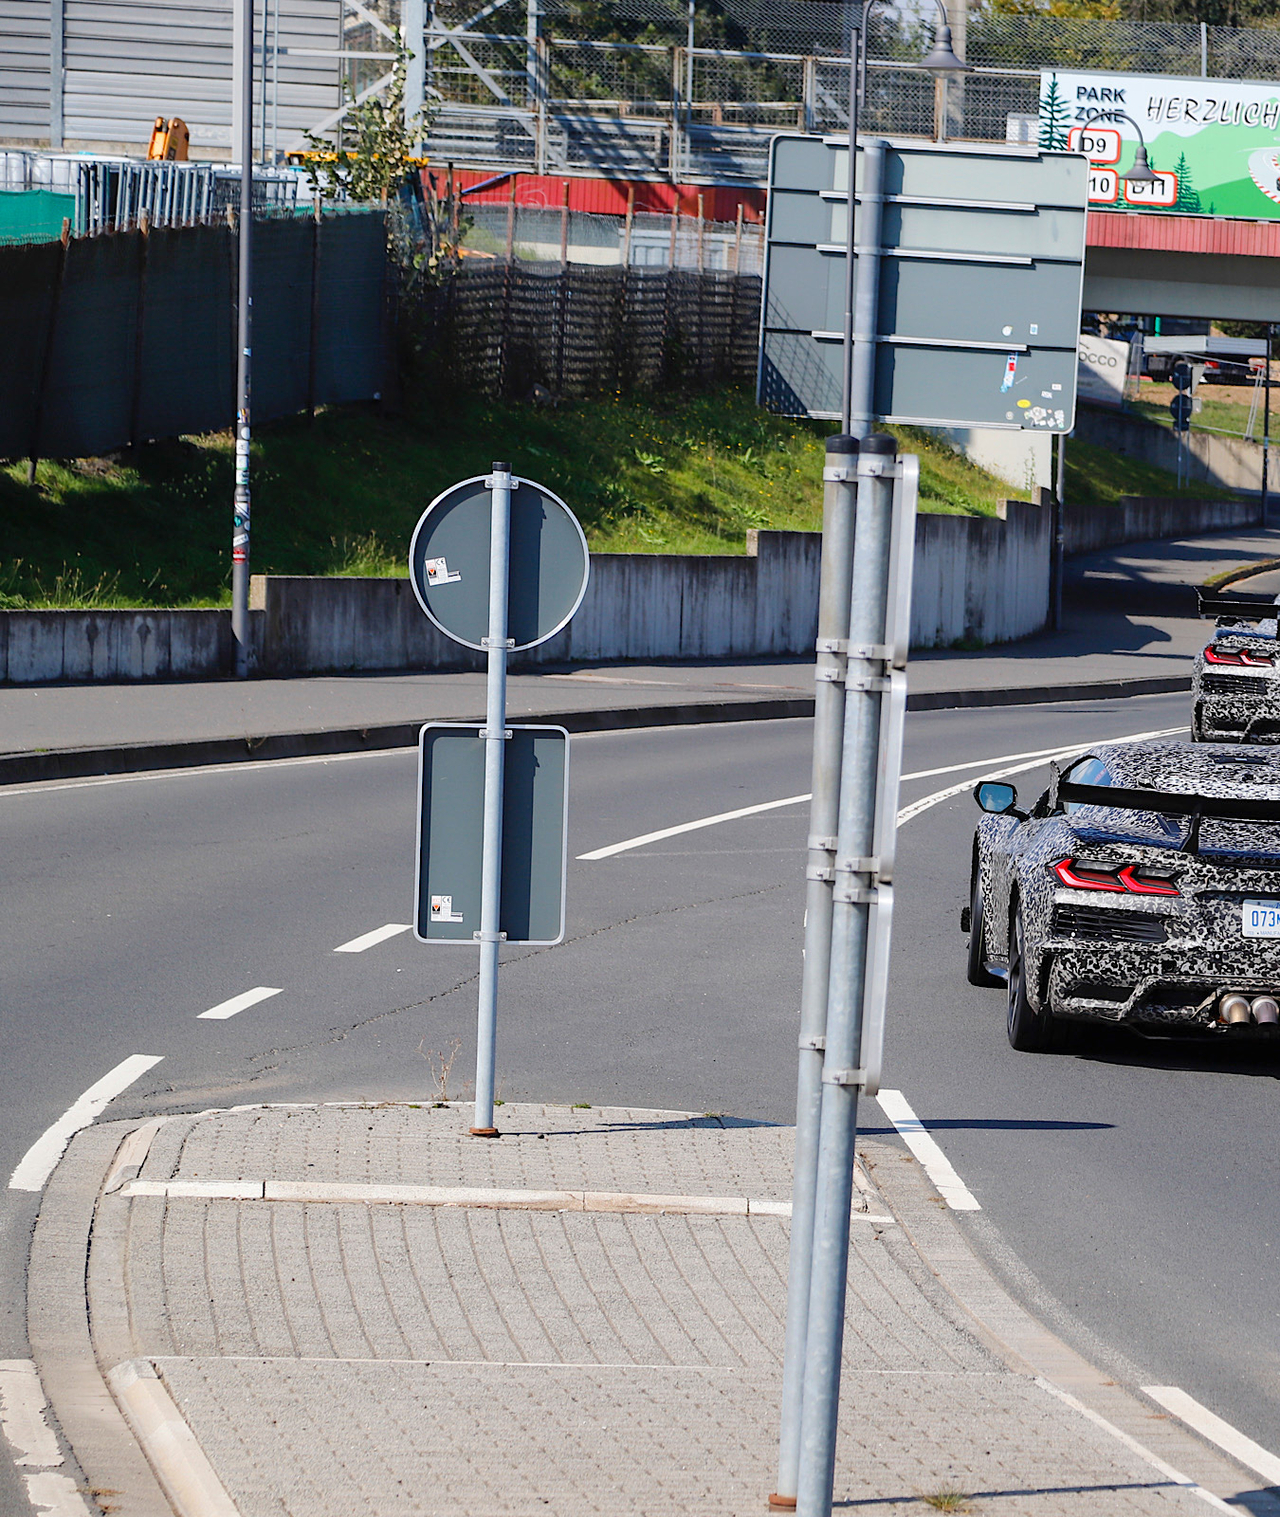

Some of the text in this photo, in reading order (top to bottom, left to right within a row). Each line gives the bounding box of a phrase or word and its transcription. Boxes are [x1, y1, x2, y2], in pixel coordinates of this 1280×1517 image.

[1076, 86, 1125, 102] PARK
[1074, 106, 1125, 123] ZONE
[1147, 96, 1280, 128] HERZLICH
[1082, 137, 1106, 153] D9
[1089, 177, 1110, 193] 10
